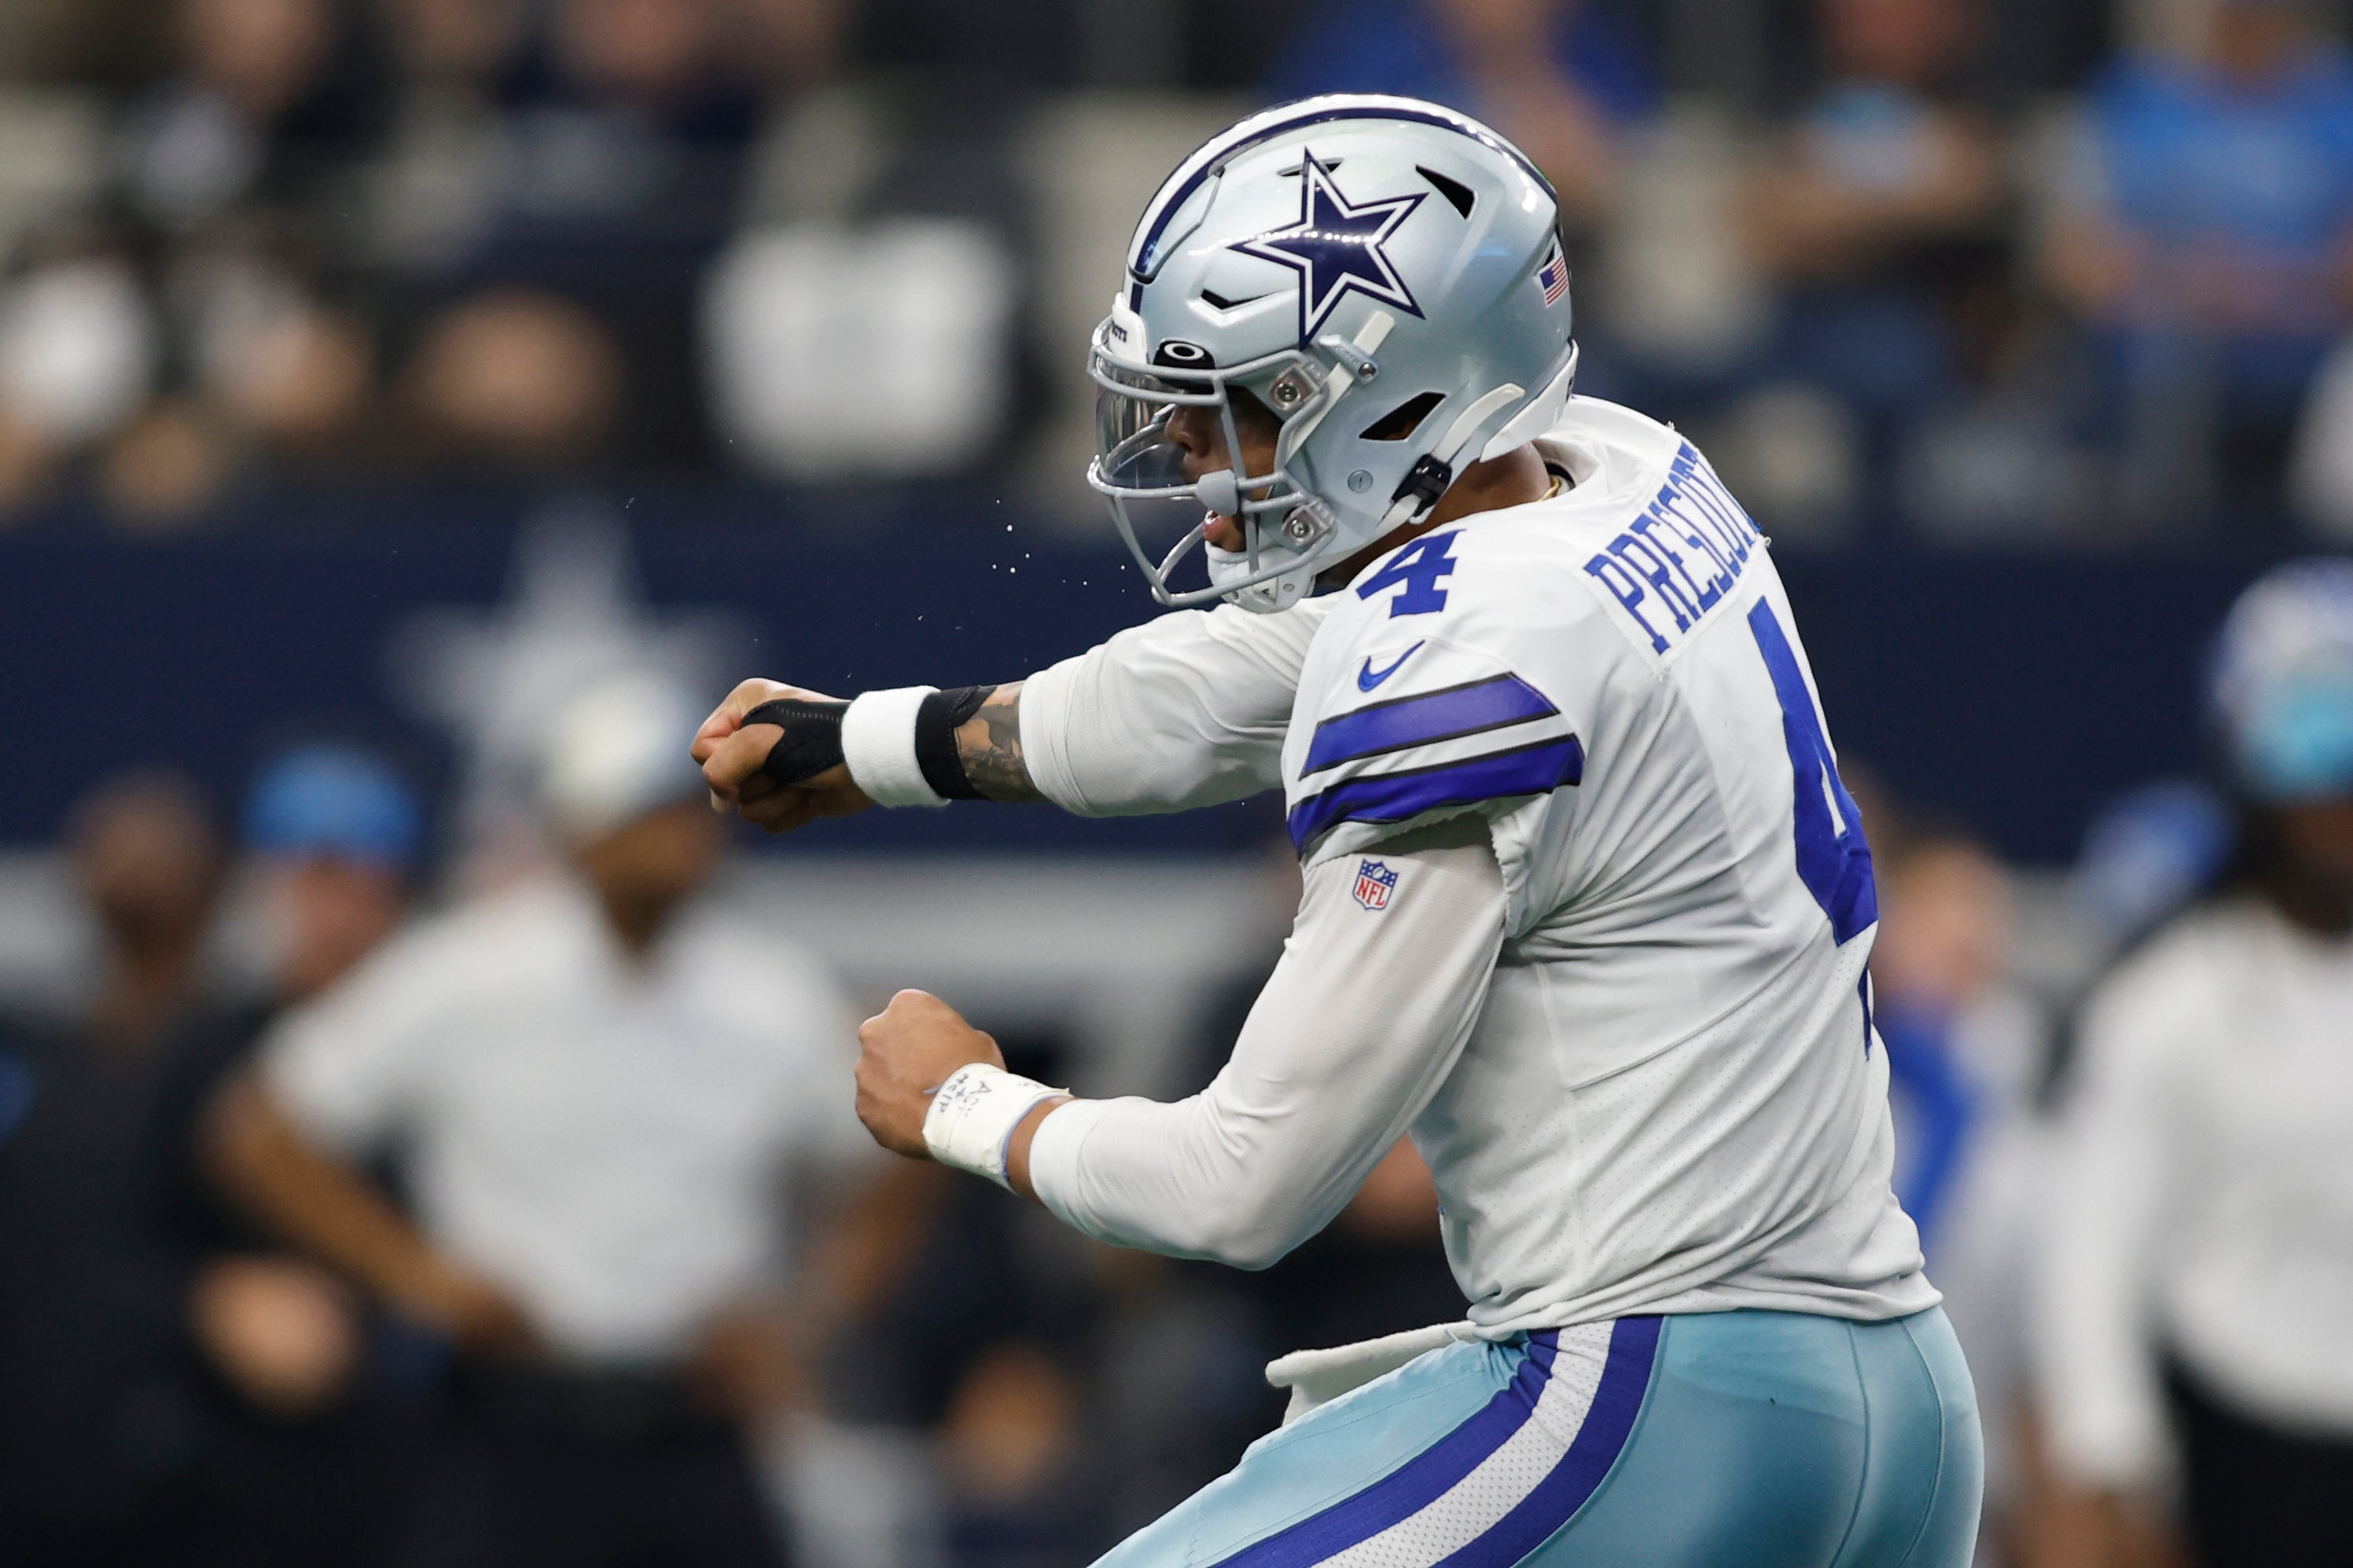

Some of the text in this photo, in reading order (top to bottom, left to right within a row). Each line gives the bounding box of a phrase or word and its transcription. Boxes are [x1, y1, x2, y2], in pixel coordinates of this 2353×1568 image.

[1355, 528, 1467, 619] 4
[1747, 595, 1879, 1061] 4
[1355, 877, 1387, 906] NFL
